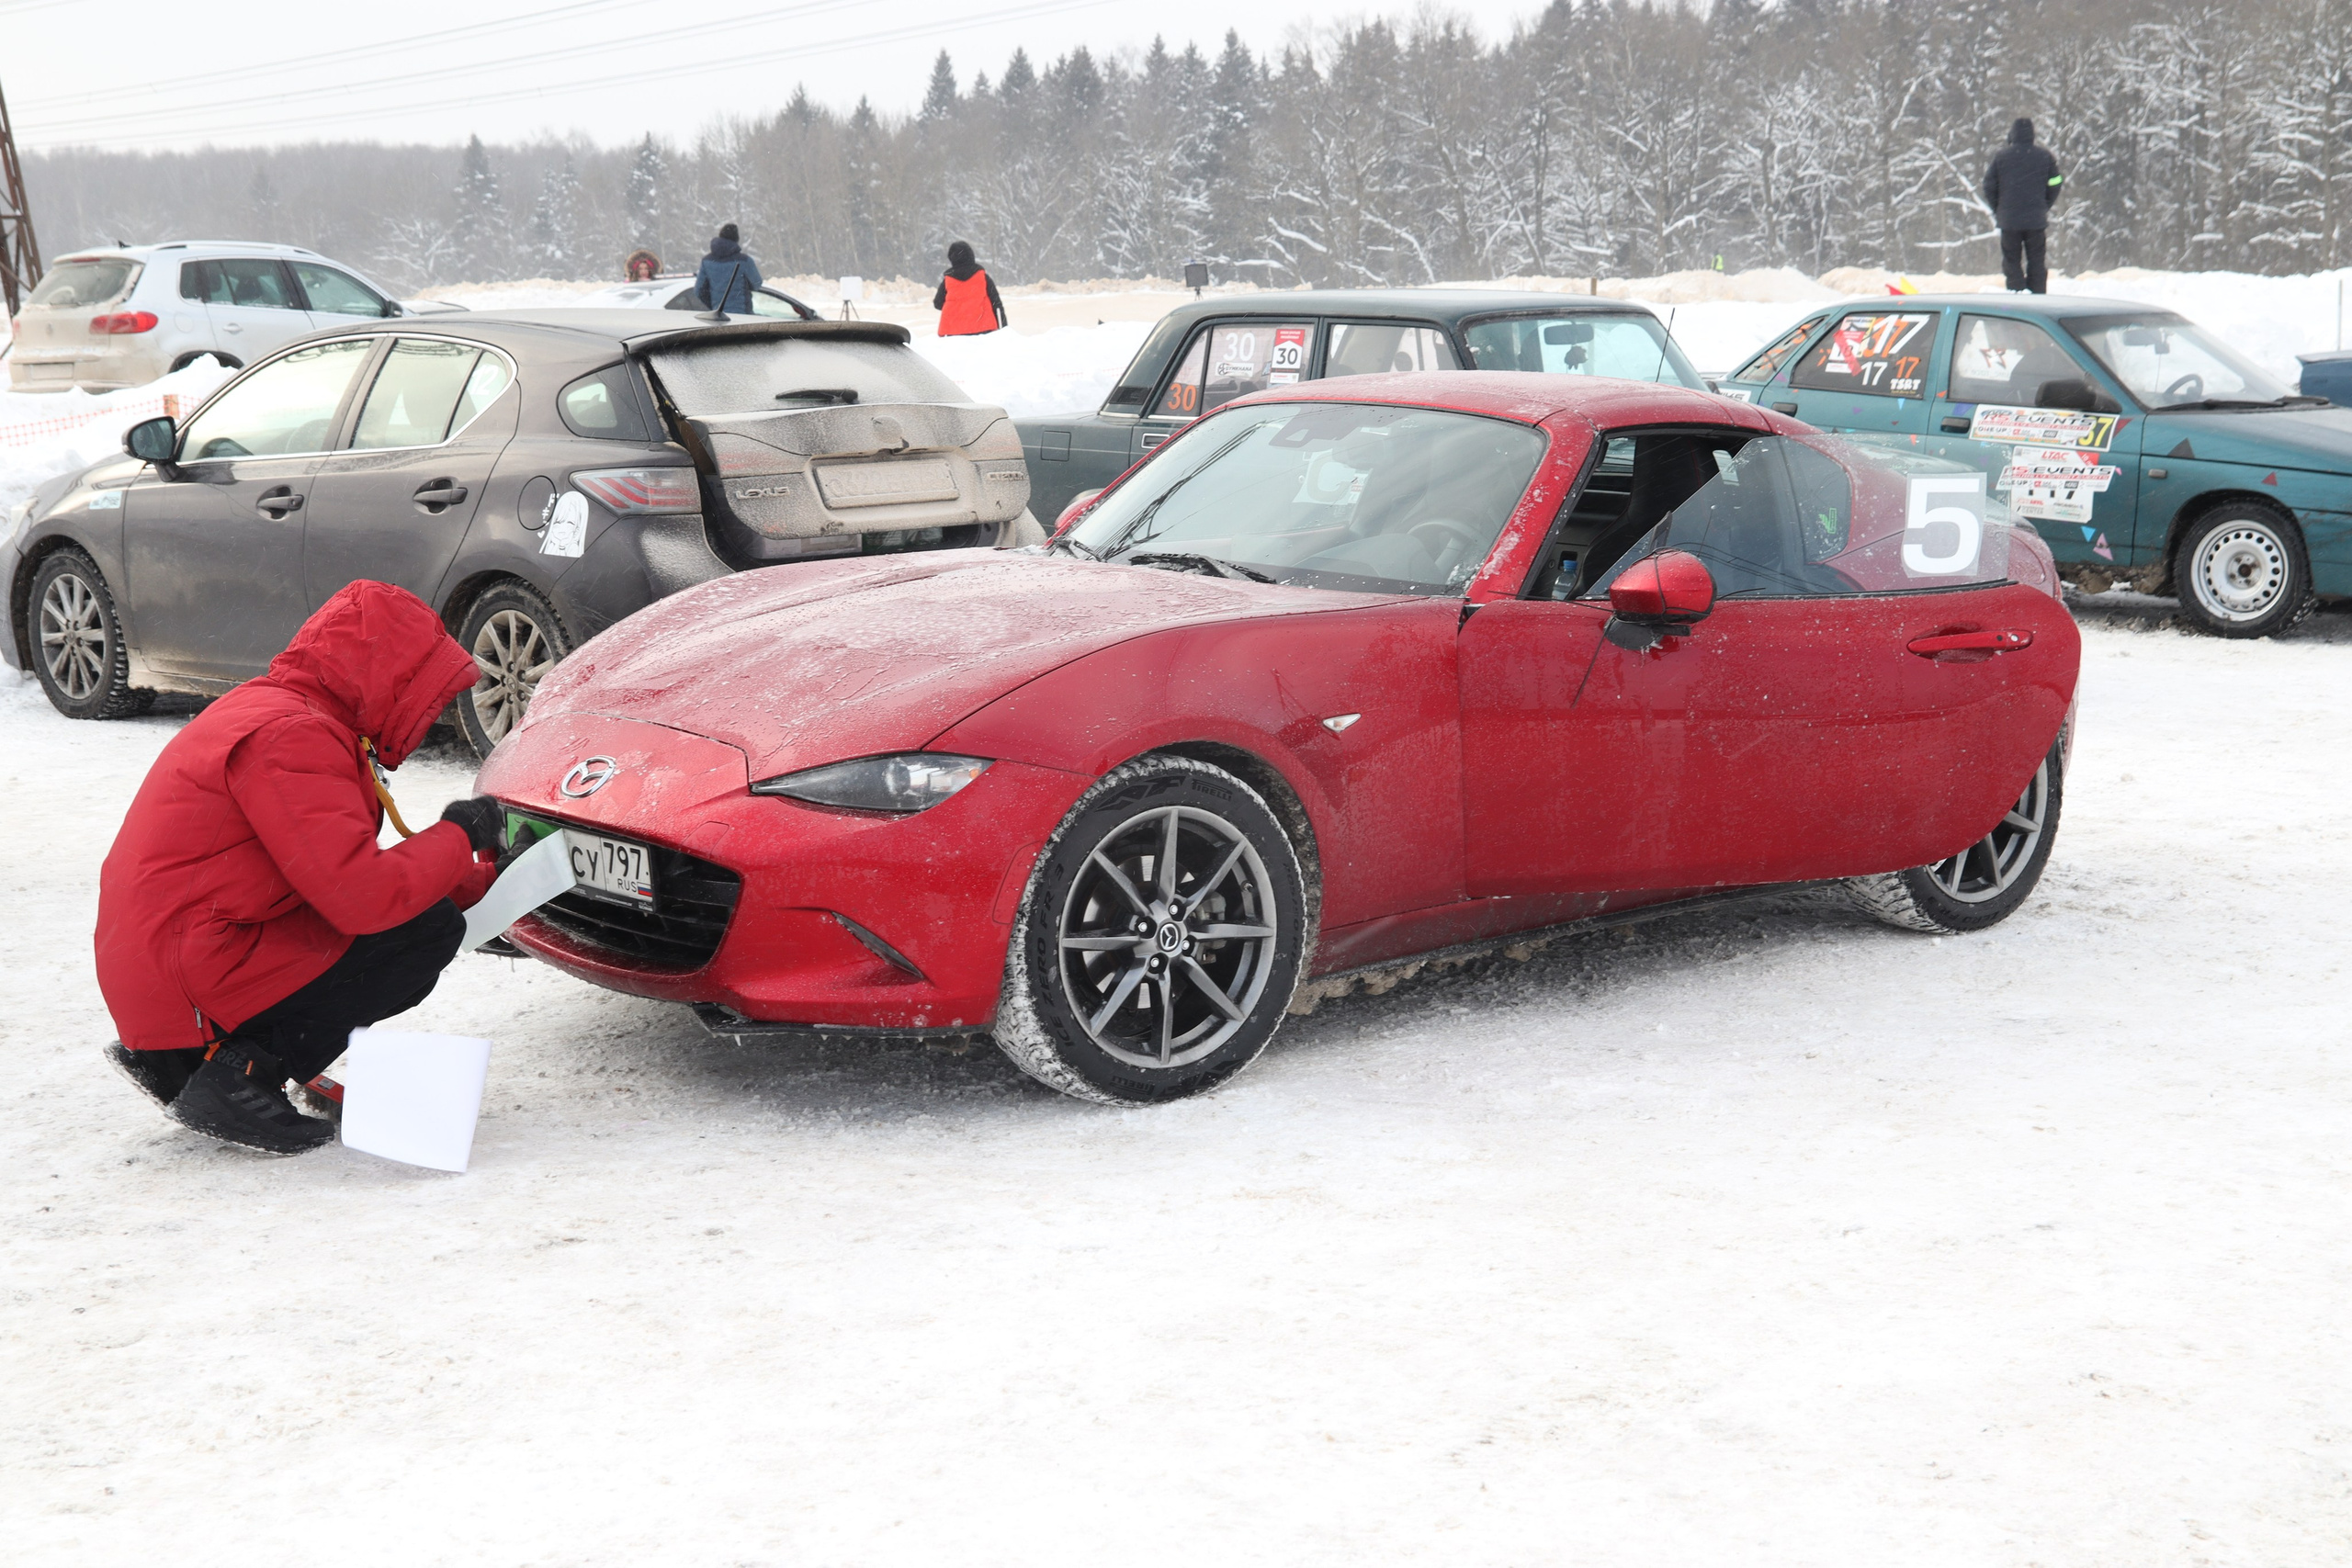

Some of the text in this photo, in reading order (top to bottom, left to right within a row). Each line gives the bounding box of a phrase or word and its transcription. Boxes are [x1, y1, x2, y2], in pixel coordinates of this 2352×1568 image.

[1223, 332, 1255, 362] 30
[1872, 314, 1930, 355] 17
[1275, 347, 1298, 366] 30
[1895, 356, 1921, 378] 17
[469, 364, 499, 395] 12
[1860, 361, 1888, 386] 17
[1167, 382, 1197, 412] 30
[2014, 414, 2097, 426] EVENTS
[2033, 467, 2112, 475] EVENTS
[735, 486, 790, 500] LEXUS
[1902, 478, 1981, 575] 5
[1191, 778, 1234, 802] PIRELLI
[603, 841, 641, 880] 797
[616, 878, 638, 893] RUS
[1037, 937, 1054, 1007] ZERO
